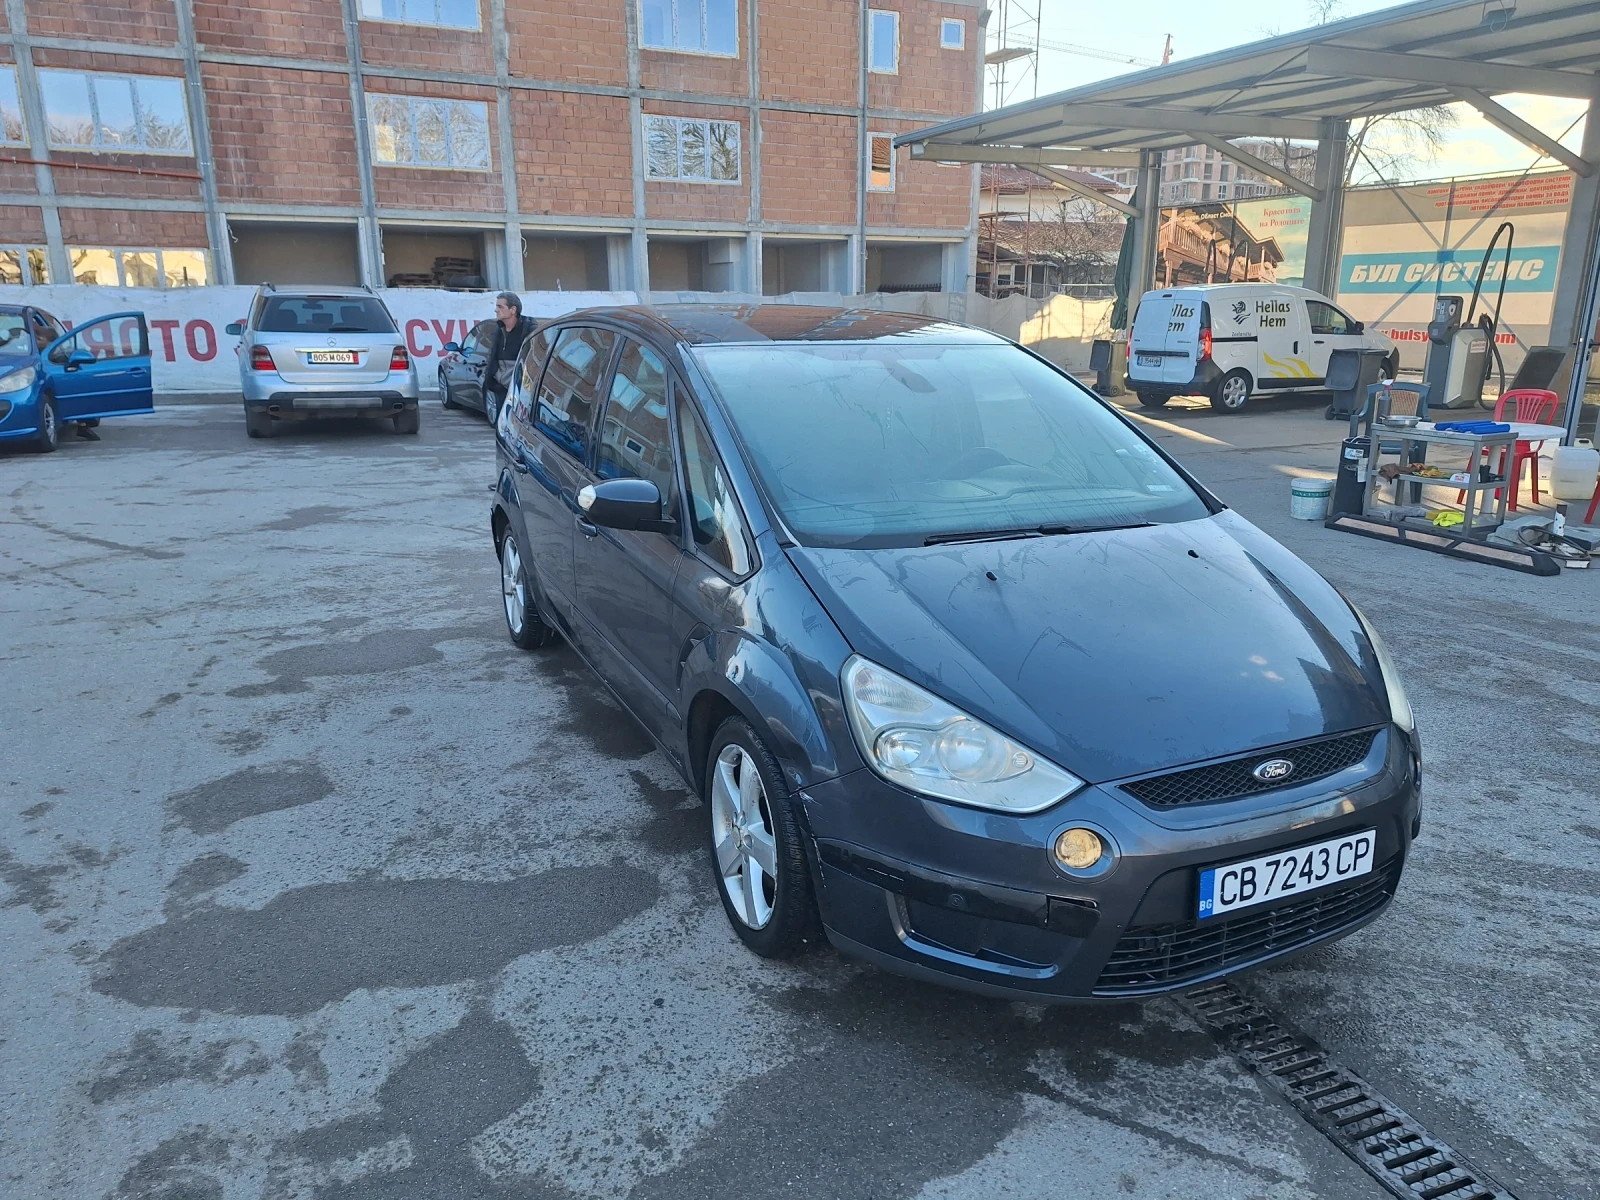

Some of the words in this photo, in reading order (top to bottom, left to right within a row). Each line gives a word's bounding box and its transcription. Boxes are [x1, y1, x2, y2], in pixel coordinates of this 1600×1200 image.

[1349, 264, 1402, 283] БУЛ
[1404, 259, 1545, 283] СИСТЕМС
[1171, 303, 1195, 318] llas
[1255, 300, 1291, 313] Hellas
[1259, 315, 1286, 328] Hem
[1265, 763, 1287, 778] Ford
[1220, 866, 1257, 906] CB
[1264, 847, 1330, 896] 7243
[1336, 837, 1370, 876] CP
[1199, 899, 1213, 912] BG
